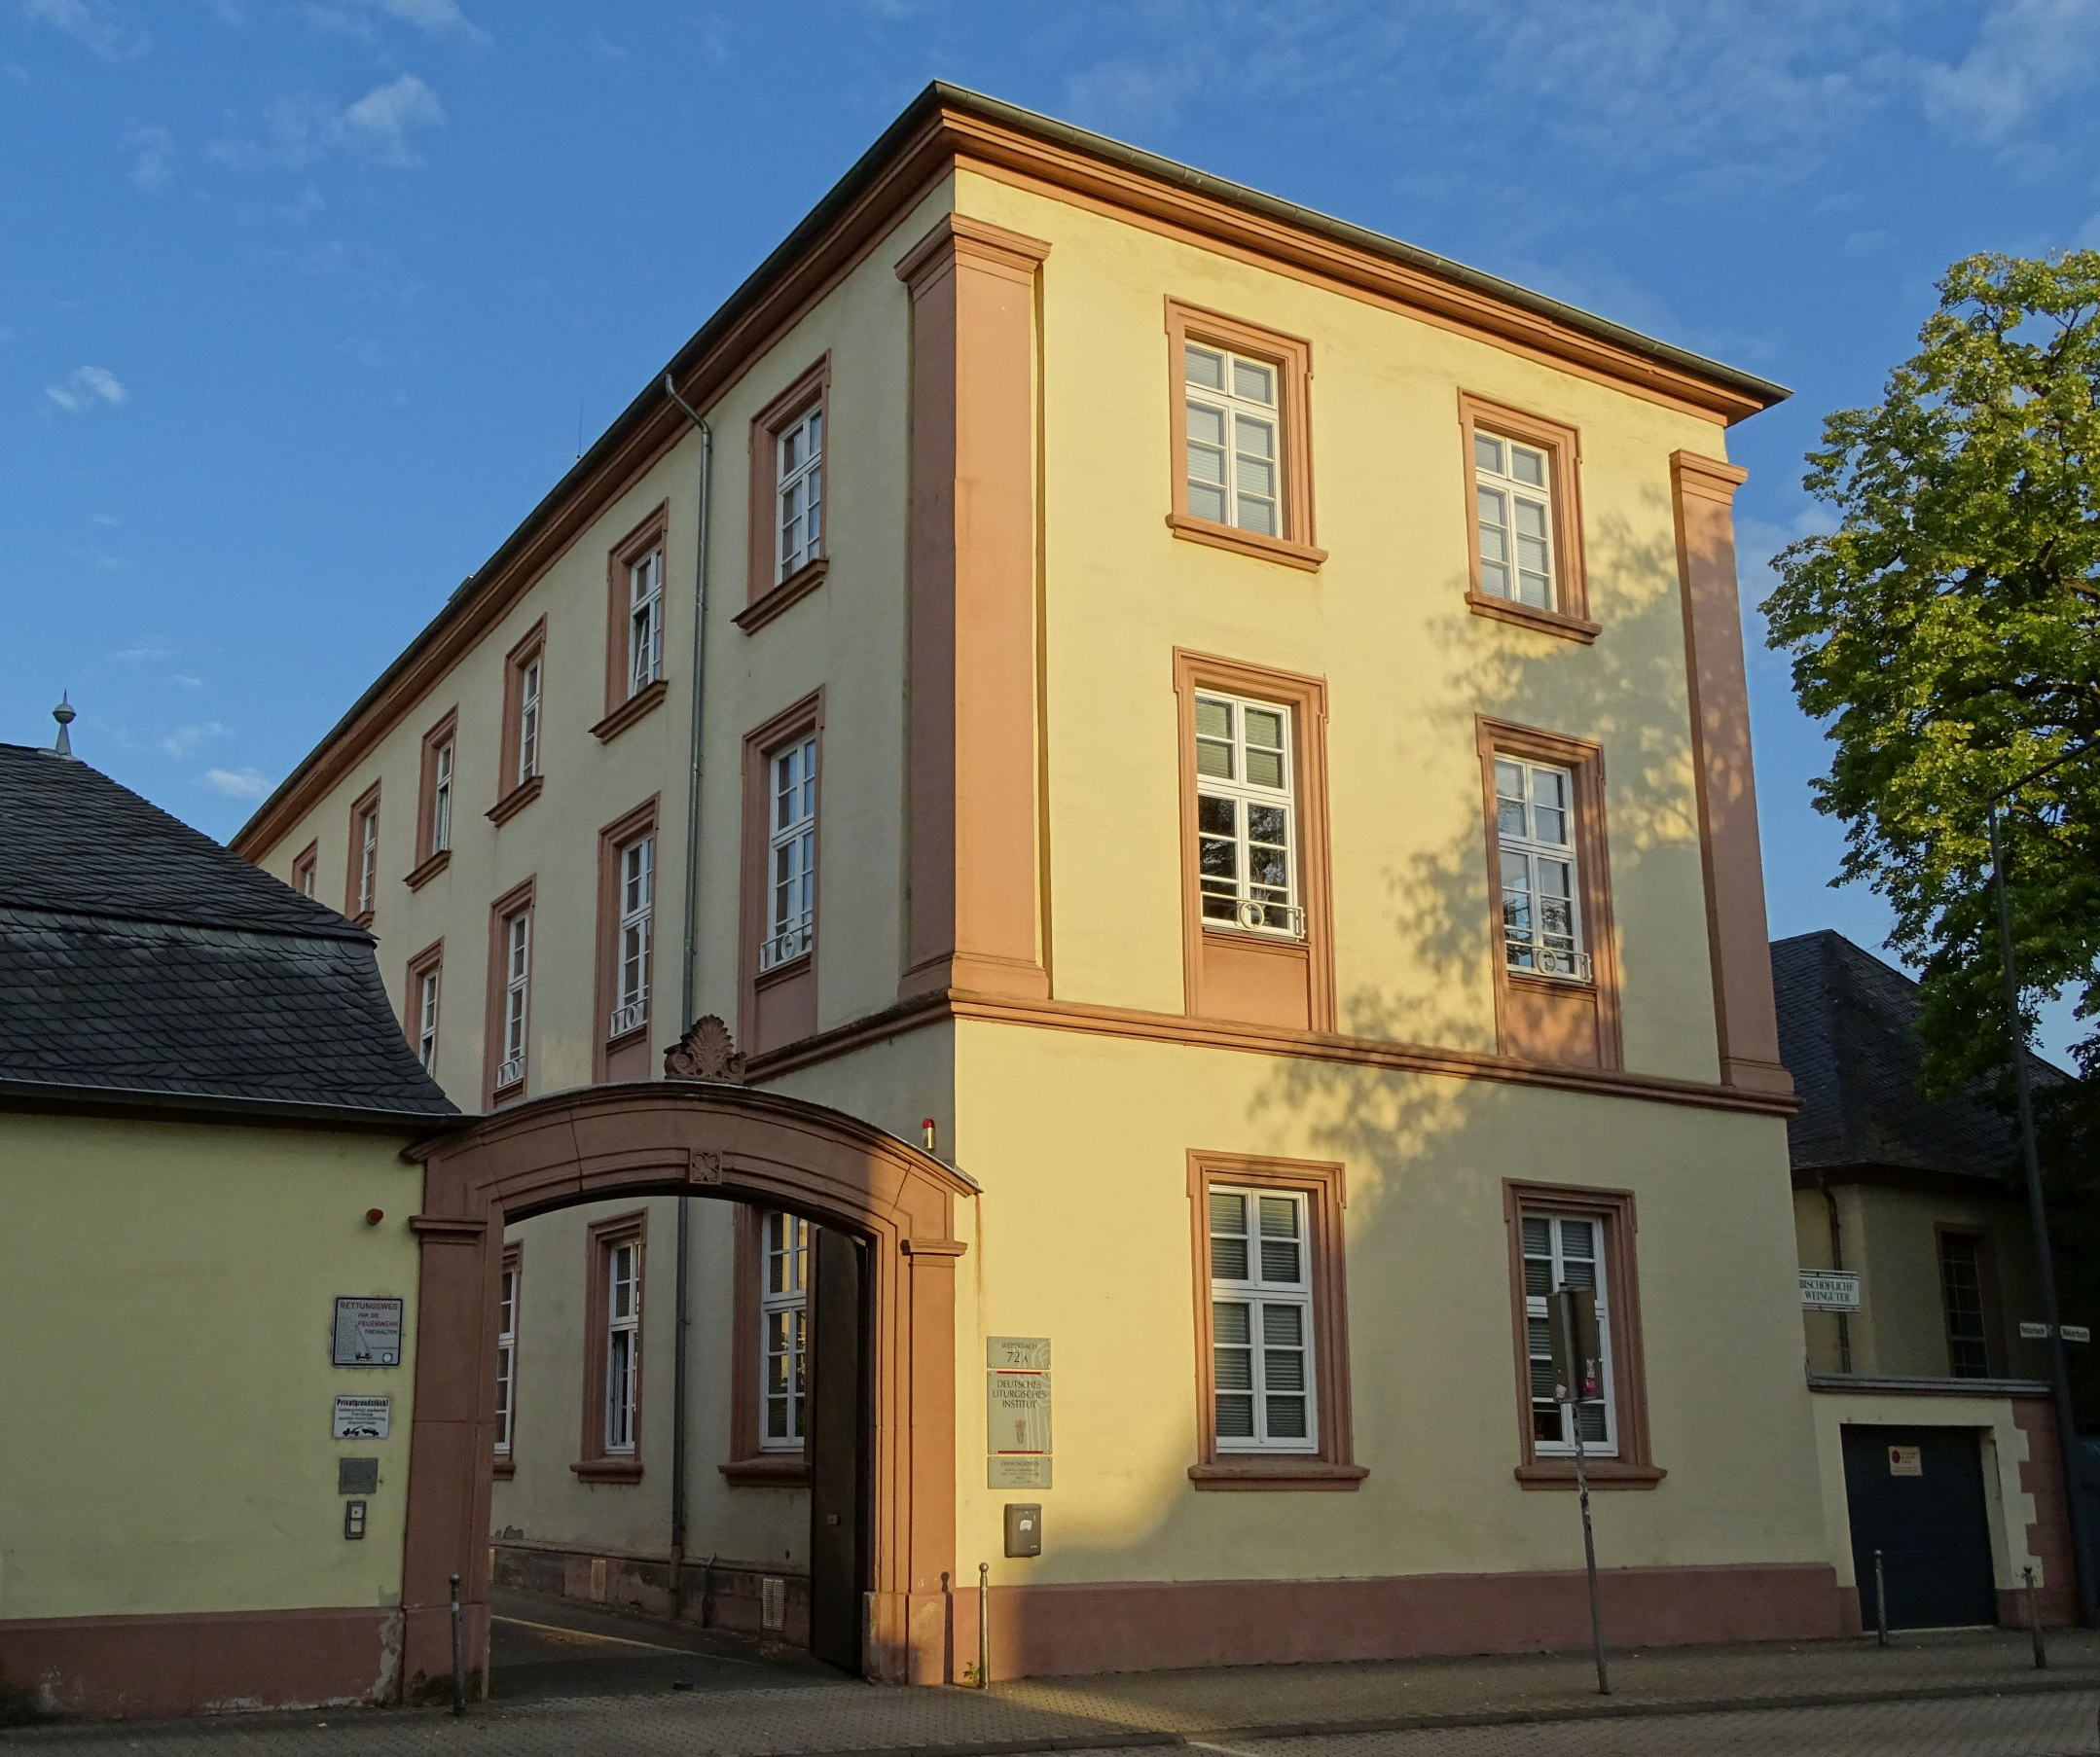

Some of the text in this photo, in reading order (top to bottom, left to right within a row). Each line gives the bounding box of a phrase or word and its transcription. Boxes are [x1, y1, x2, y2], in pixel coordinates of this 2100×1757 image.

[340, 1302, 398, 1310] RETTUNGSWEG
[1007, 1351, 1020, 1363] 72
[996, 1380, 1042, 1389] DEUTSCHES
[993, 1389, 1047, 1399] LITURGISCHES
[1002, 1399, 1037, 1409] INSTITUT
